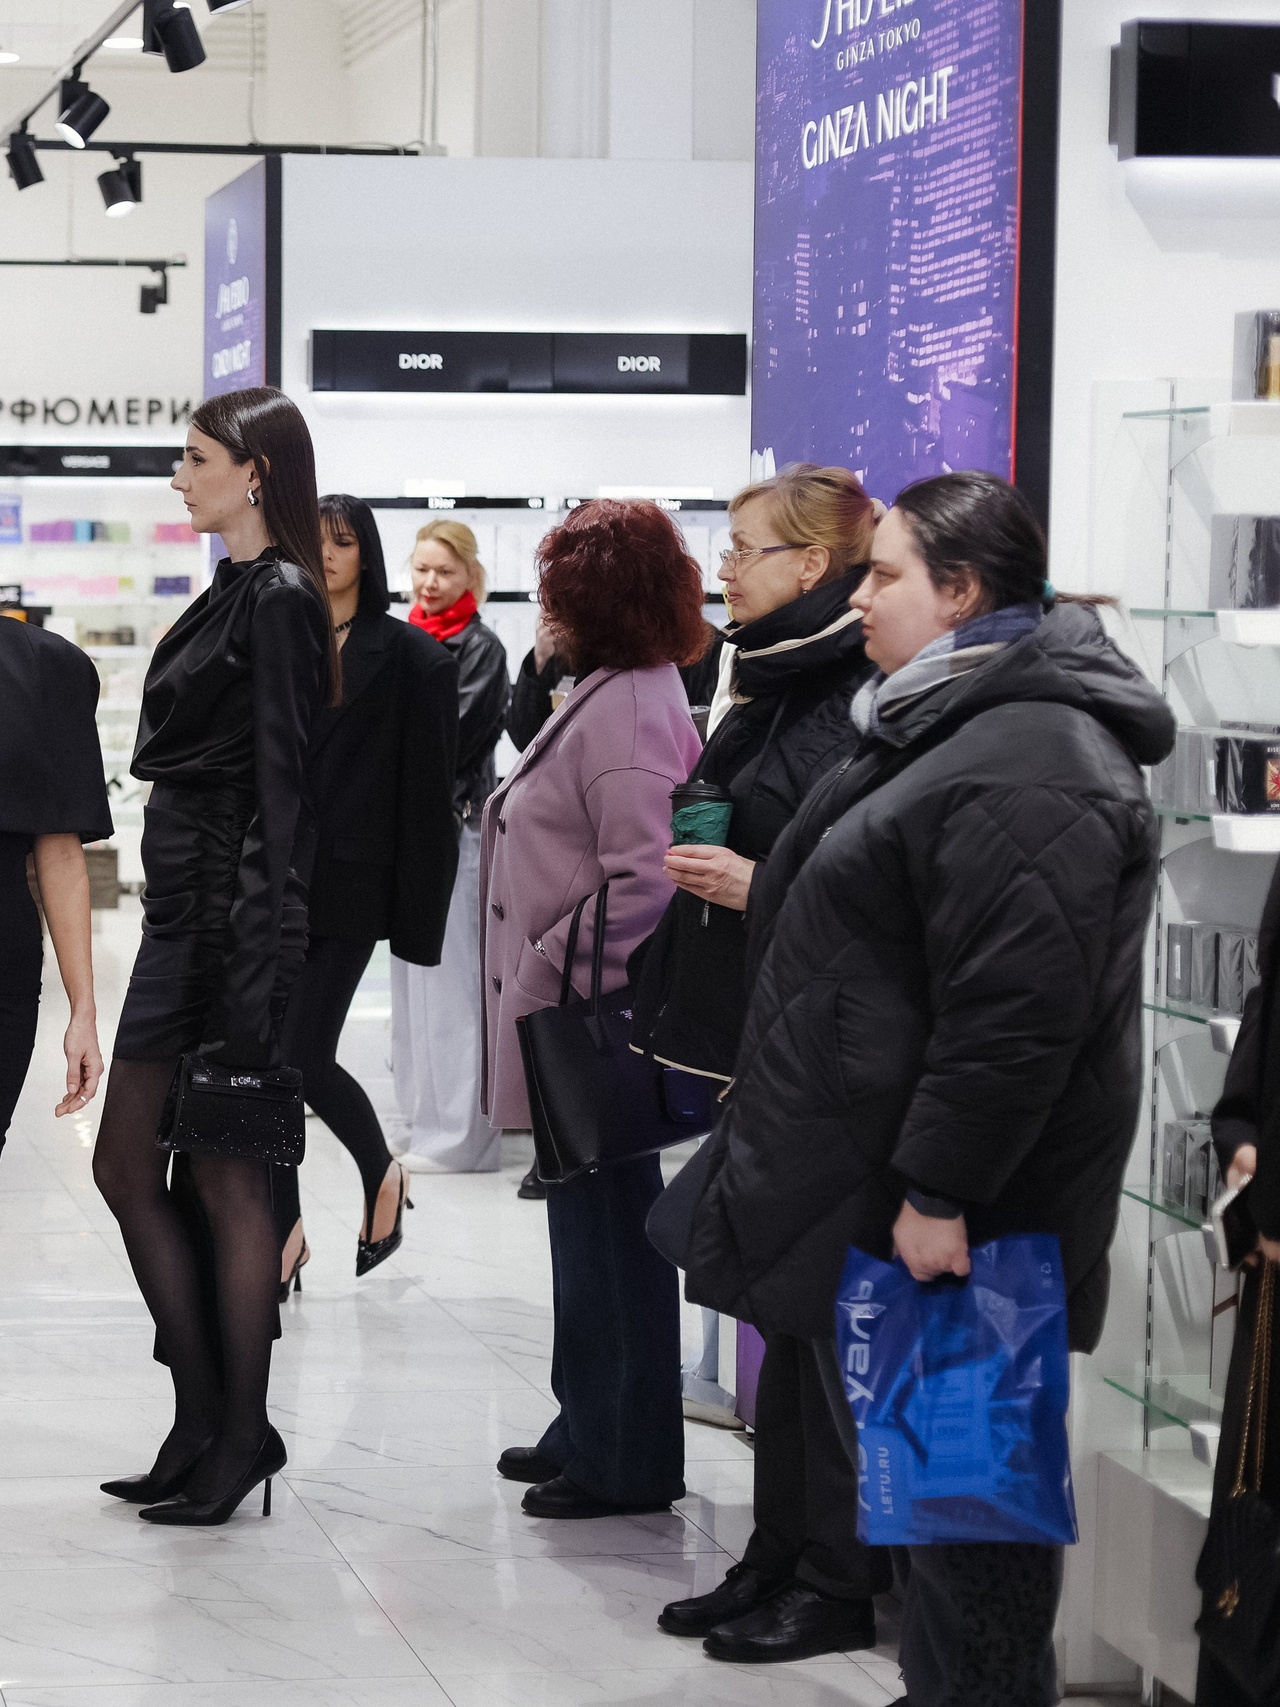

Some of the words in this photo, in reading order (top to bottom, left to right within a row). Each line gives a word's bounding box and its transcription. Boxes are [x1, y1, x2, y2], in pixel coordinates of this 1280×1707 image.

[836, 38, 875, 71] GINZA
[879, 18, 920, 53] TOKYO
[802, 100, 870, 169] GINZA
[876, 65, 954, 144] NIGHT
[398, 353, 443, 369] DIOR
[617, 356, 661, 372] DIOR
[877, 1447, 895, 1515] LETU.RU
